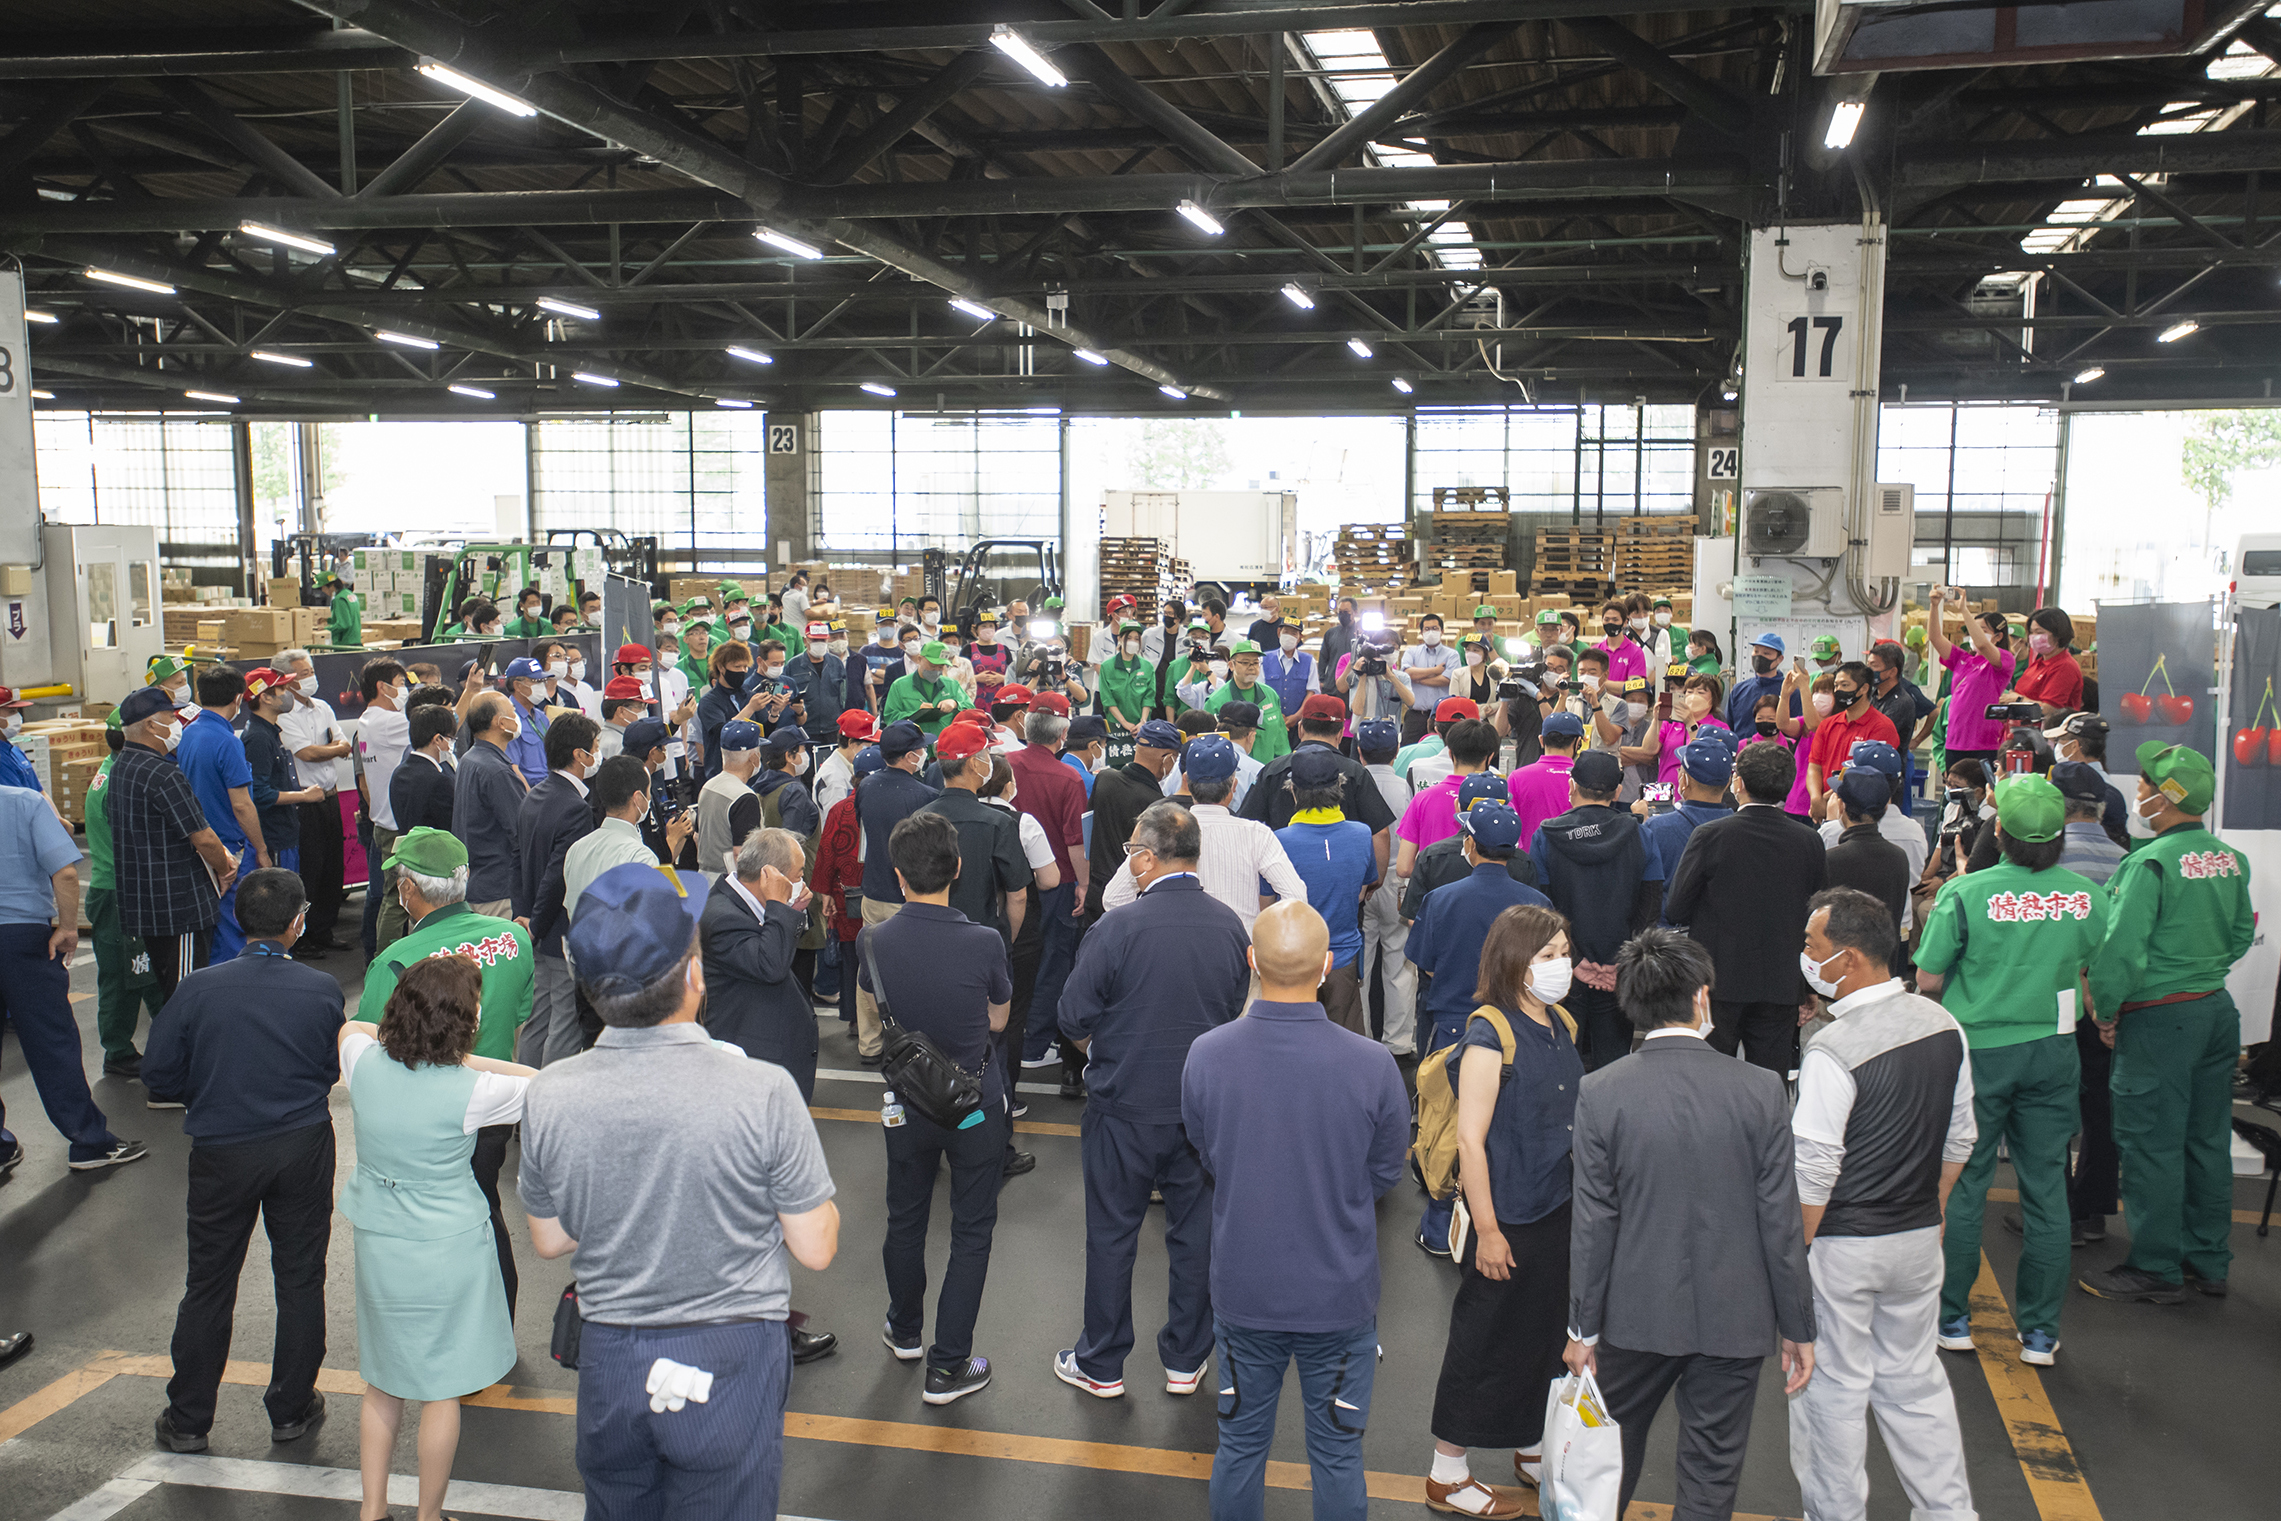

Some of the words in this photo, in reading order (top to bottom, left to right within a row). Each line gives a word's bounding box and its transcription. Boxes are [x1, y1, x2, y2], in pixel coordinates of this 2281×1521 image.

[1787, 316, 1843, 377] 17
[773, 427, 794, 452] 23
[1711, 450, 1736, 477] 24
[12, 609, 22, 632] プラ
[1669, 668, 1686, 676] 626
[1626, 682, 1644, 691] 264
[49, 734, 76, 745] きゅうり
[67, 748, 94, 759] きゅうり
[1988, 891, 2091, 922] 情熱市場
